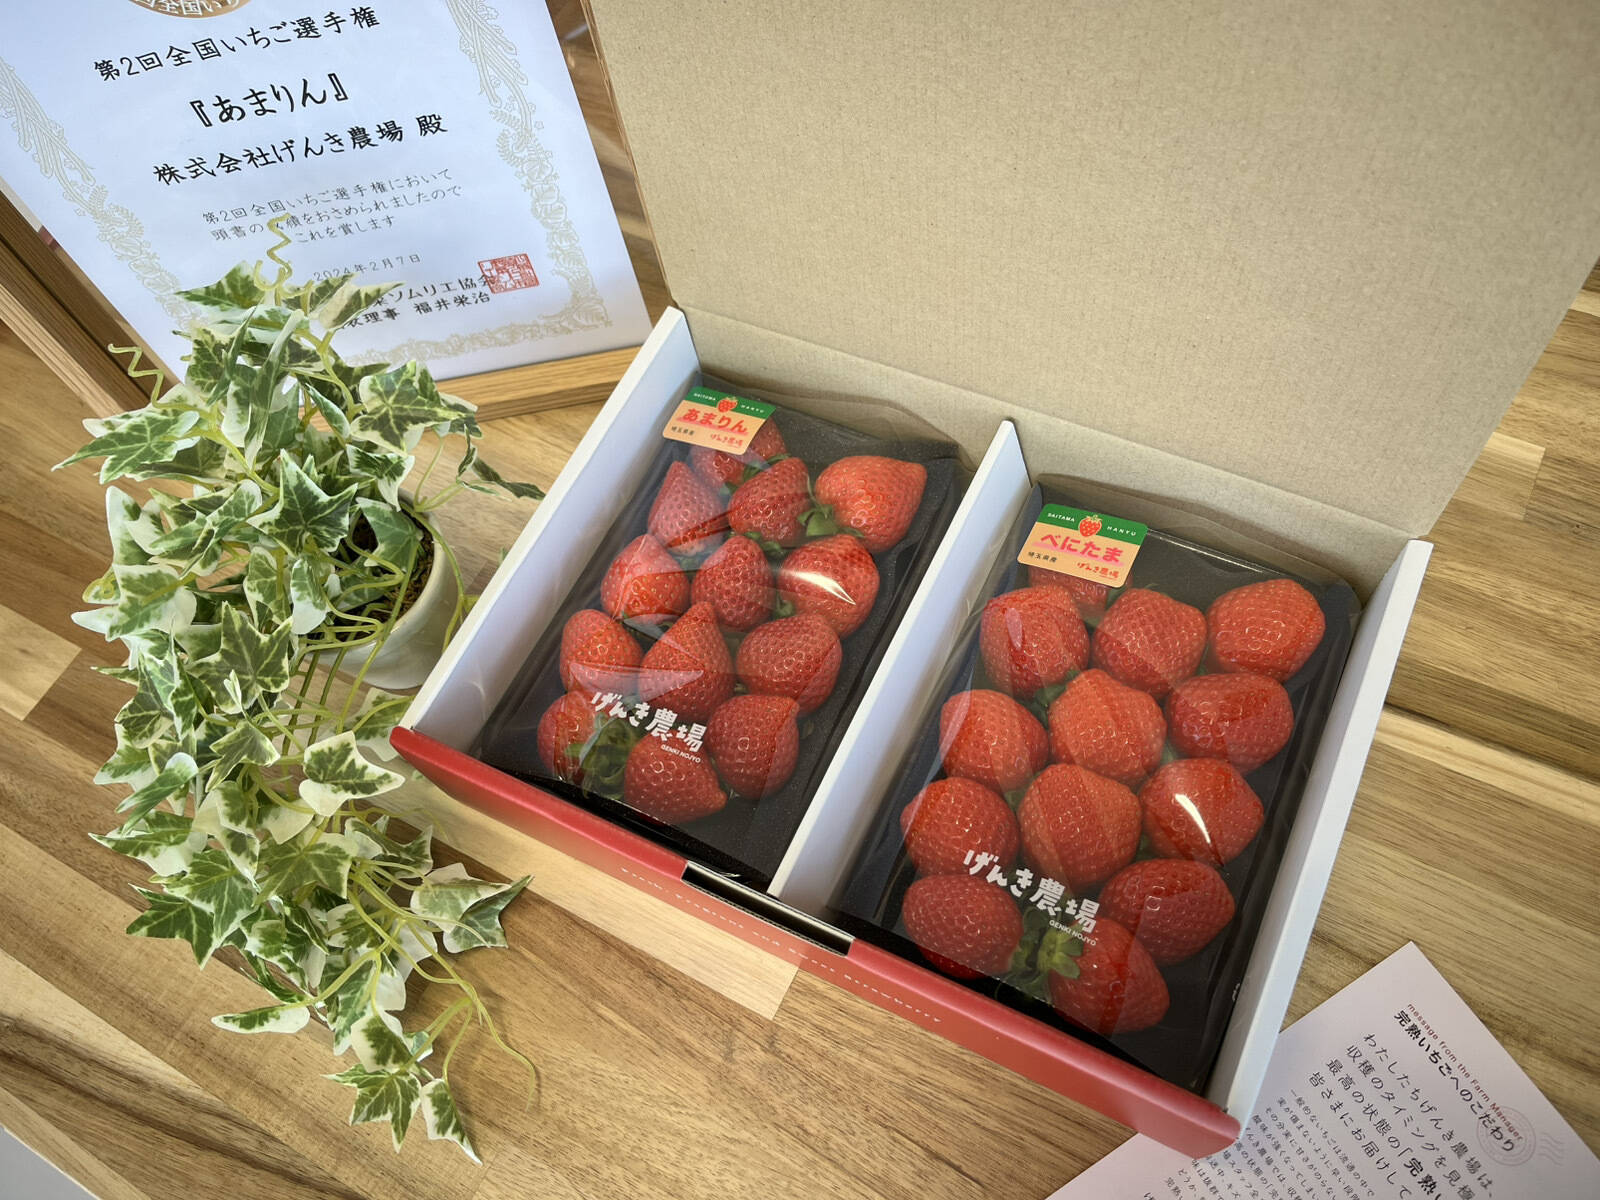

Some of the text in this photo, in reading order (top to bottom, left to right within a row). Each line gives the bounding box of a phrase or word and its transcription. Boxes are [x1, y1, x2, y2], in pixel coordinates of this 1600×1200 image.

[94, 6, 380, 81] 第2回全国いちご選手権
[189, 73, 349, 128] 『あまりん』
[153, 113, 448, 186] 株式会社げんき農場 殿
[203, 168, 452, 225] 第2回全国いちご選手権において
[211, 185, 462, 240] 頭書の績をおさめられましたので
[295, 215, 395, 243] これを賞します
[413, 292, 491, 315] 福井栄治
[683, 408, 748, 433] あまりん
[1047, 513, 1075, 522] SAITAMA
[1040, 533, 1123, 562] べにたま
[591, 692, 707, 752] げんき農場
[963, 849, 1100, 934] げんき農場
[1049, 919, 1073, 935] GENKI
[1393, 1010, 1515, 1152] 完熟いちごへのこだわり
[1407, 1003, 1524, 1141] message from the Farm Manager
[1363, 1033, 1493, 1199] わたしたちげんき農場は、
